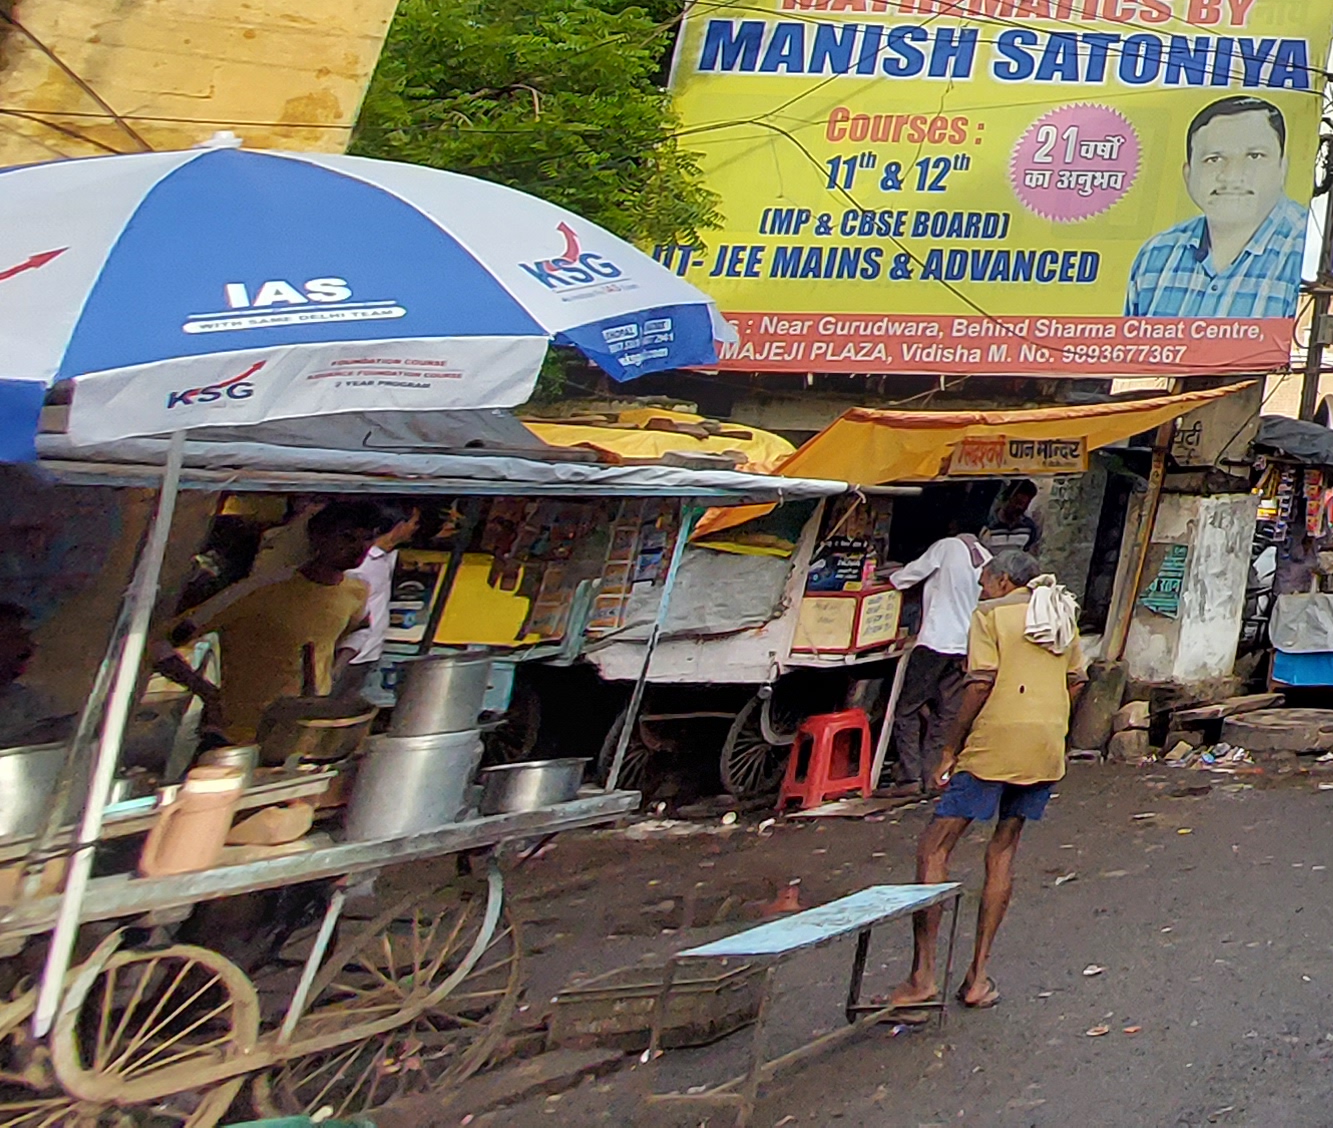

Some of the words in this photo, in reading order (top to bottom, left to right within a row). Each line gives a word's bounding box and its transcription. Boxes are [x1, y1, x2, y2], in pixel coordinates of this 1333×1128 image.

[698, 20, 979, 79] MANISH
[993, 29, 1310, 88] SATONIYA
[826, 106, 968, 145] Courses
[1033, 125, 1079, 163] 21
[1079, 135, 1125, 160] वर्षों
[826, 151, 877, 189] 11th
[879, 161, 904, 191] &
[915, 153, 971, 192] 12th
[1024, 170, 1052, 188] का
[1056, 170, 1126, 196] अनुभव
[759, 208, 811, 235] (MP
[815, 213, 832, 236] &
[841, 209, 908, 237] CBSE
[911, 211, 1010, 239] BOARD)
[518, 253, 622, 289] KSG
[709, 245, 766, 277] JEE
[769, 246, 883, 279] MAINS
[889, 253, 914, 280] &
[920, 248, 1100, 282] ADVANCED
[226, 276, 353, 309] IAS
[199, 320, 243, 330] WITH
[249, 316, 293, 326] SAME
[299, 312, 346, 321] DELHI
[351, 309, 393, 318] TEAM
[759, 316, 812, 335] Near
[818, 319, 944, 340] Gurudwara,
[952, 319, 1029, 337] Behind
[1034, 319, 1117, 339] Sharma
[1122, 320, 1184, 339] Chaat
[1190, 321, 1265, 341] Centre,
[810, 343, 893, 363] PLAZA,
[902, 343, 981, 362] Vidisha
[988, 344, 1012, 362] M.
[1019, 344, 1055, 363] No.
[1062, 345, 1187, 364] 9893677367
[167, 381, 255, 409] KSG
[1008, 439, 1034, 460] पान
